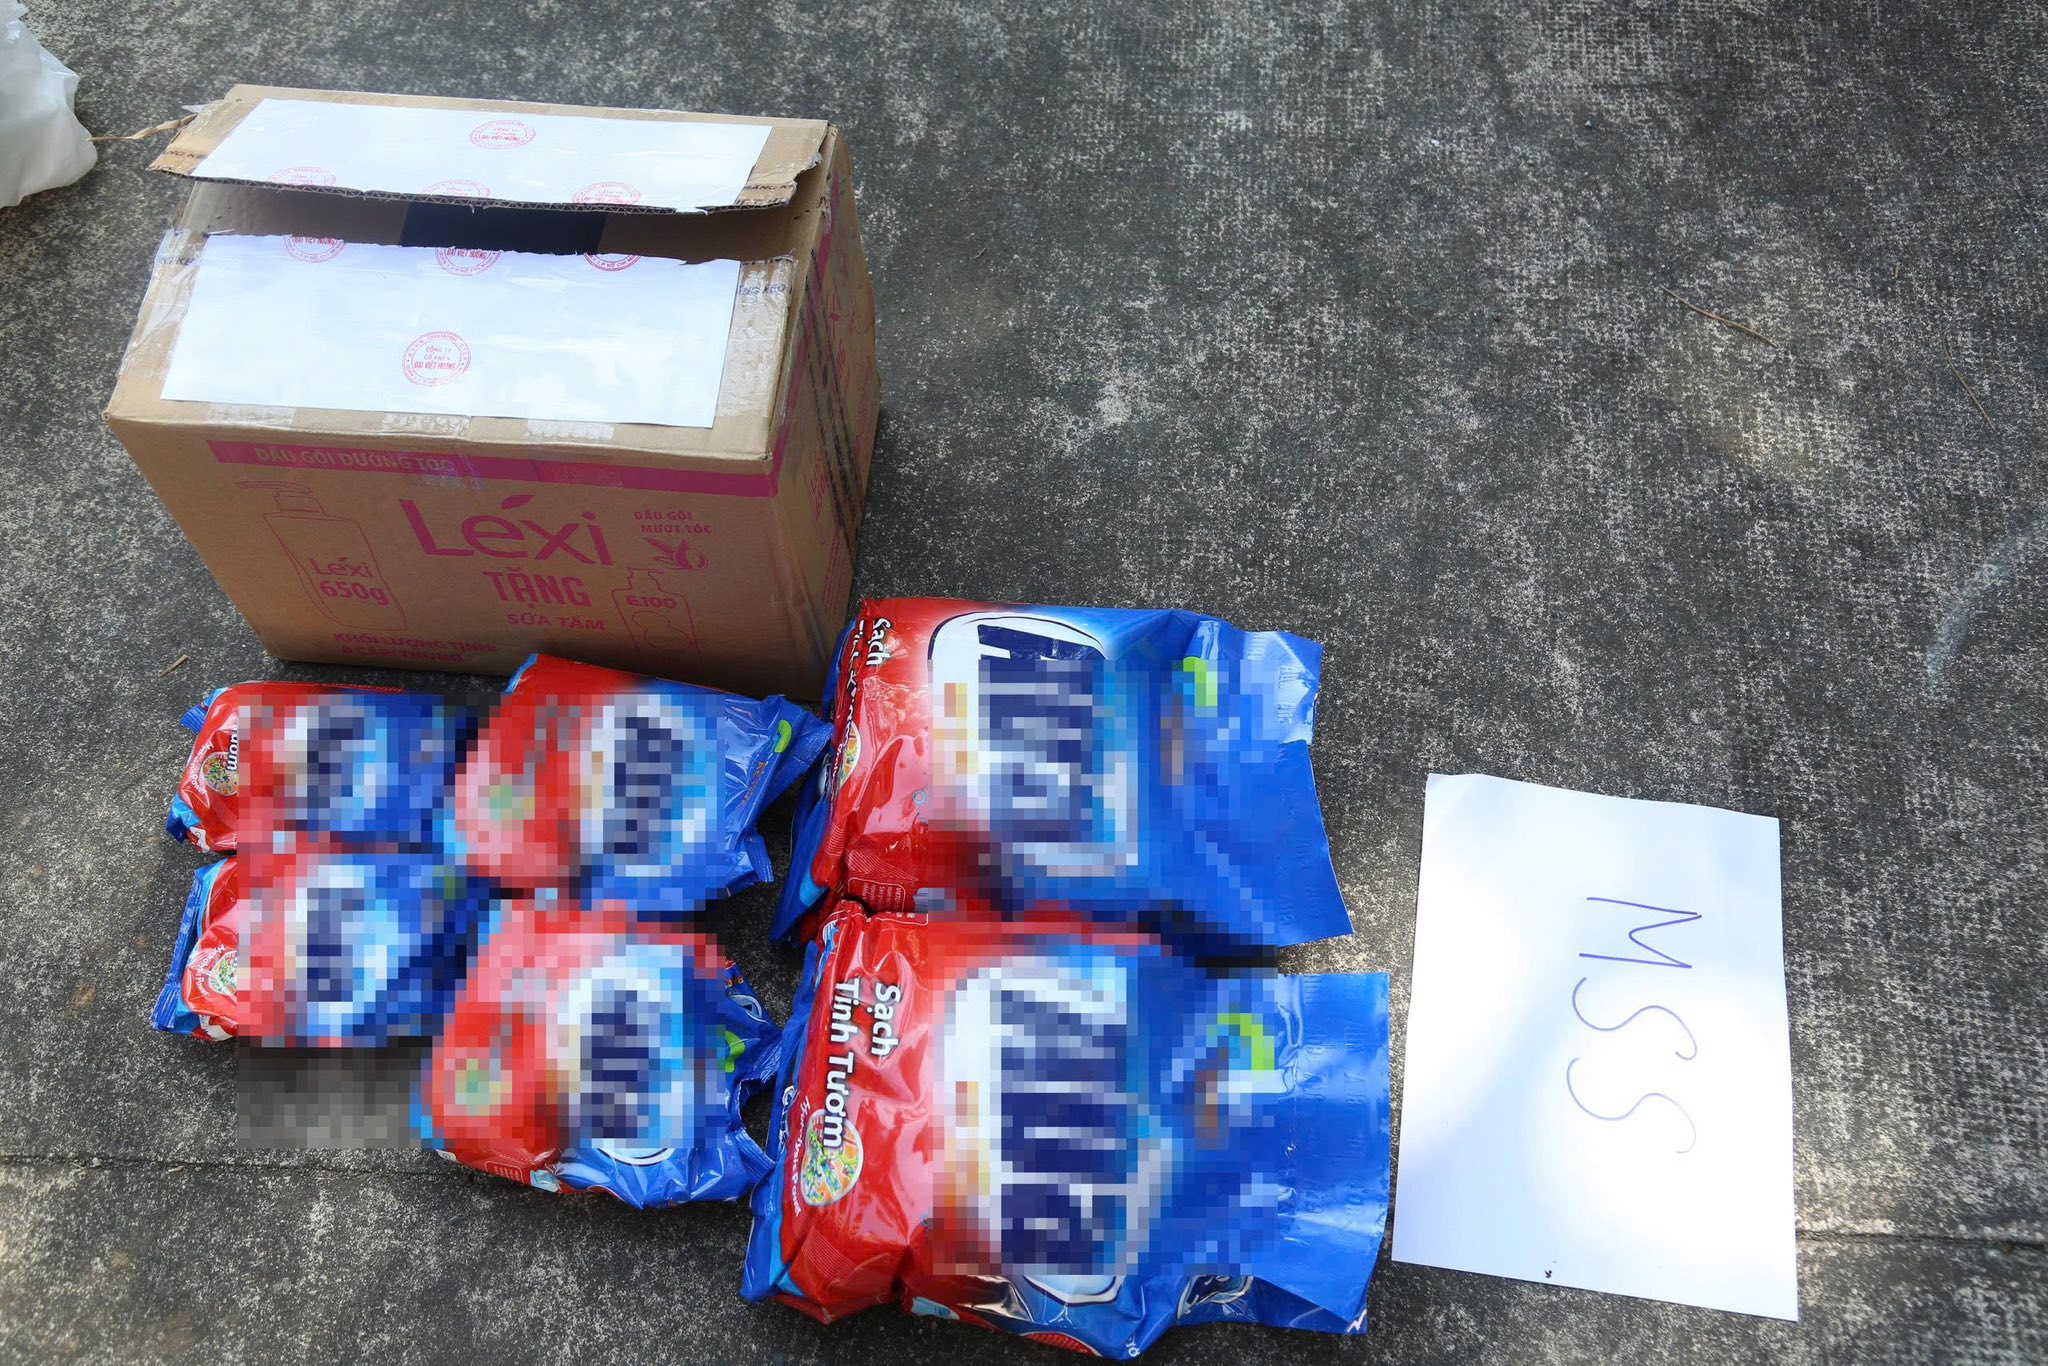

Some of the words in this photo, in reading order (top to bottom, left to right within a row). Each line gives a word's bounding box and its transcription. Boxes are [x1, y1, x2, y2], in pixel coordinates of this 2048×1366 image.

[685, 522, 713, 534] TÓC
[319, 579, 389, 608] 650g
[481, 566, 593, 609] TẶNG
[506, 611, 552, 627] SỮA
[866, 617, 892, 666] Sạch
[830, 978, 860, 1043] Tinh
[867, 981, 901, 1057] Sạch
[823, 1051, 854, 1149] Tươm
